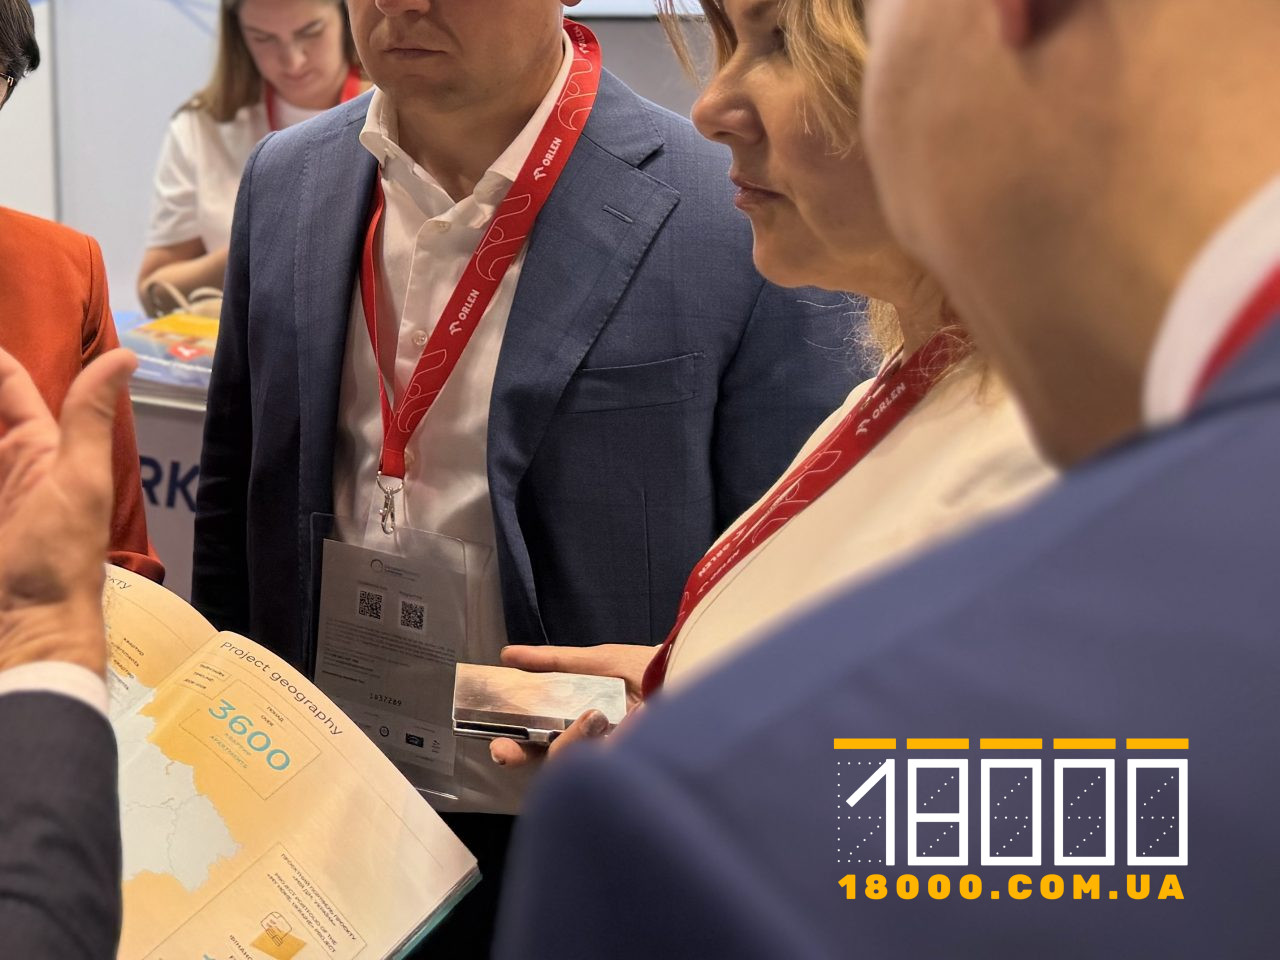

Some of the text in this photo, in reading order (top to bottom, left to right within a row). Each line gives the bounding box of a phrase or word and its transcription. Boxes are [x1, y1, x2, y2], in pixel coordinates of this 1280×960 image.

[542, 136, 562, 167] ORLEN
[458, 288, 480, 321] ORLEN
[872, 382, 906, 419] ORLEN
[220, 641, 271, 672] project
[269, 672, 343, 736] geography
[208, 698, 291, 771] 3600
